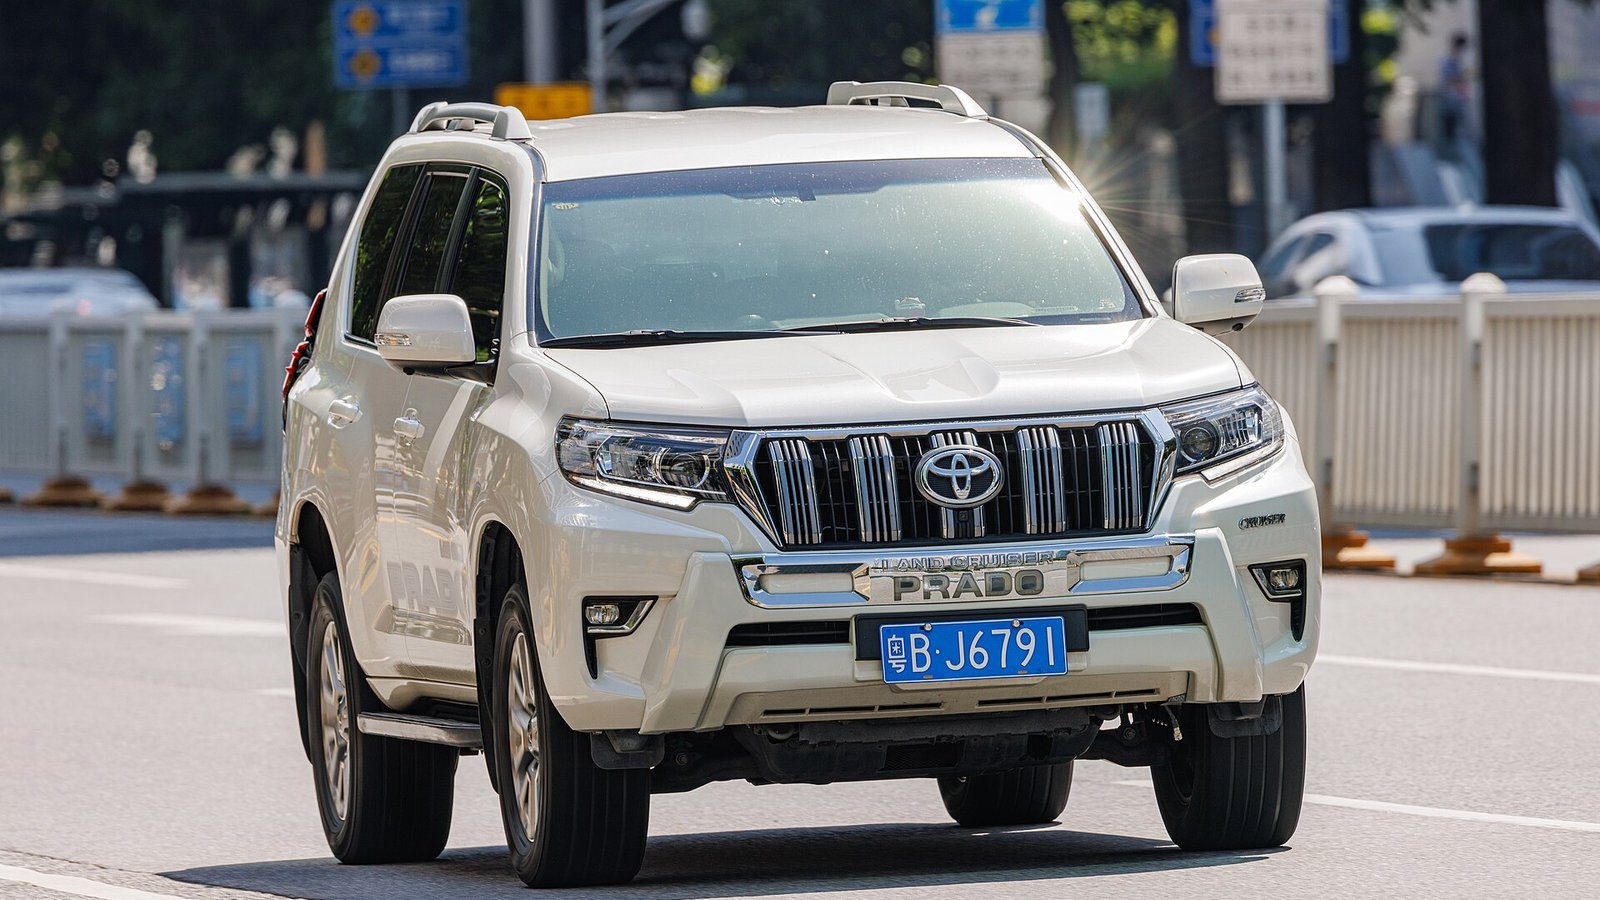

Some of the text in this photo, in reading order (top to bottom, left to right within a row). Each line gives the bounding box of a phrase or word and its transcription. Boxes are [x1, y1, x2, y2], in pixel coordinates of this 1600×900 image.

[881, 551, 1054, 572] LAND CRUISER
[893, 568, 1045, 601] PRADO
